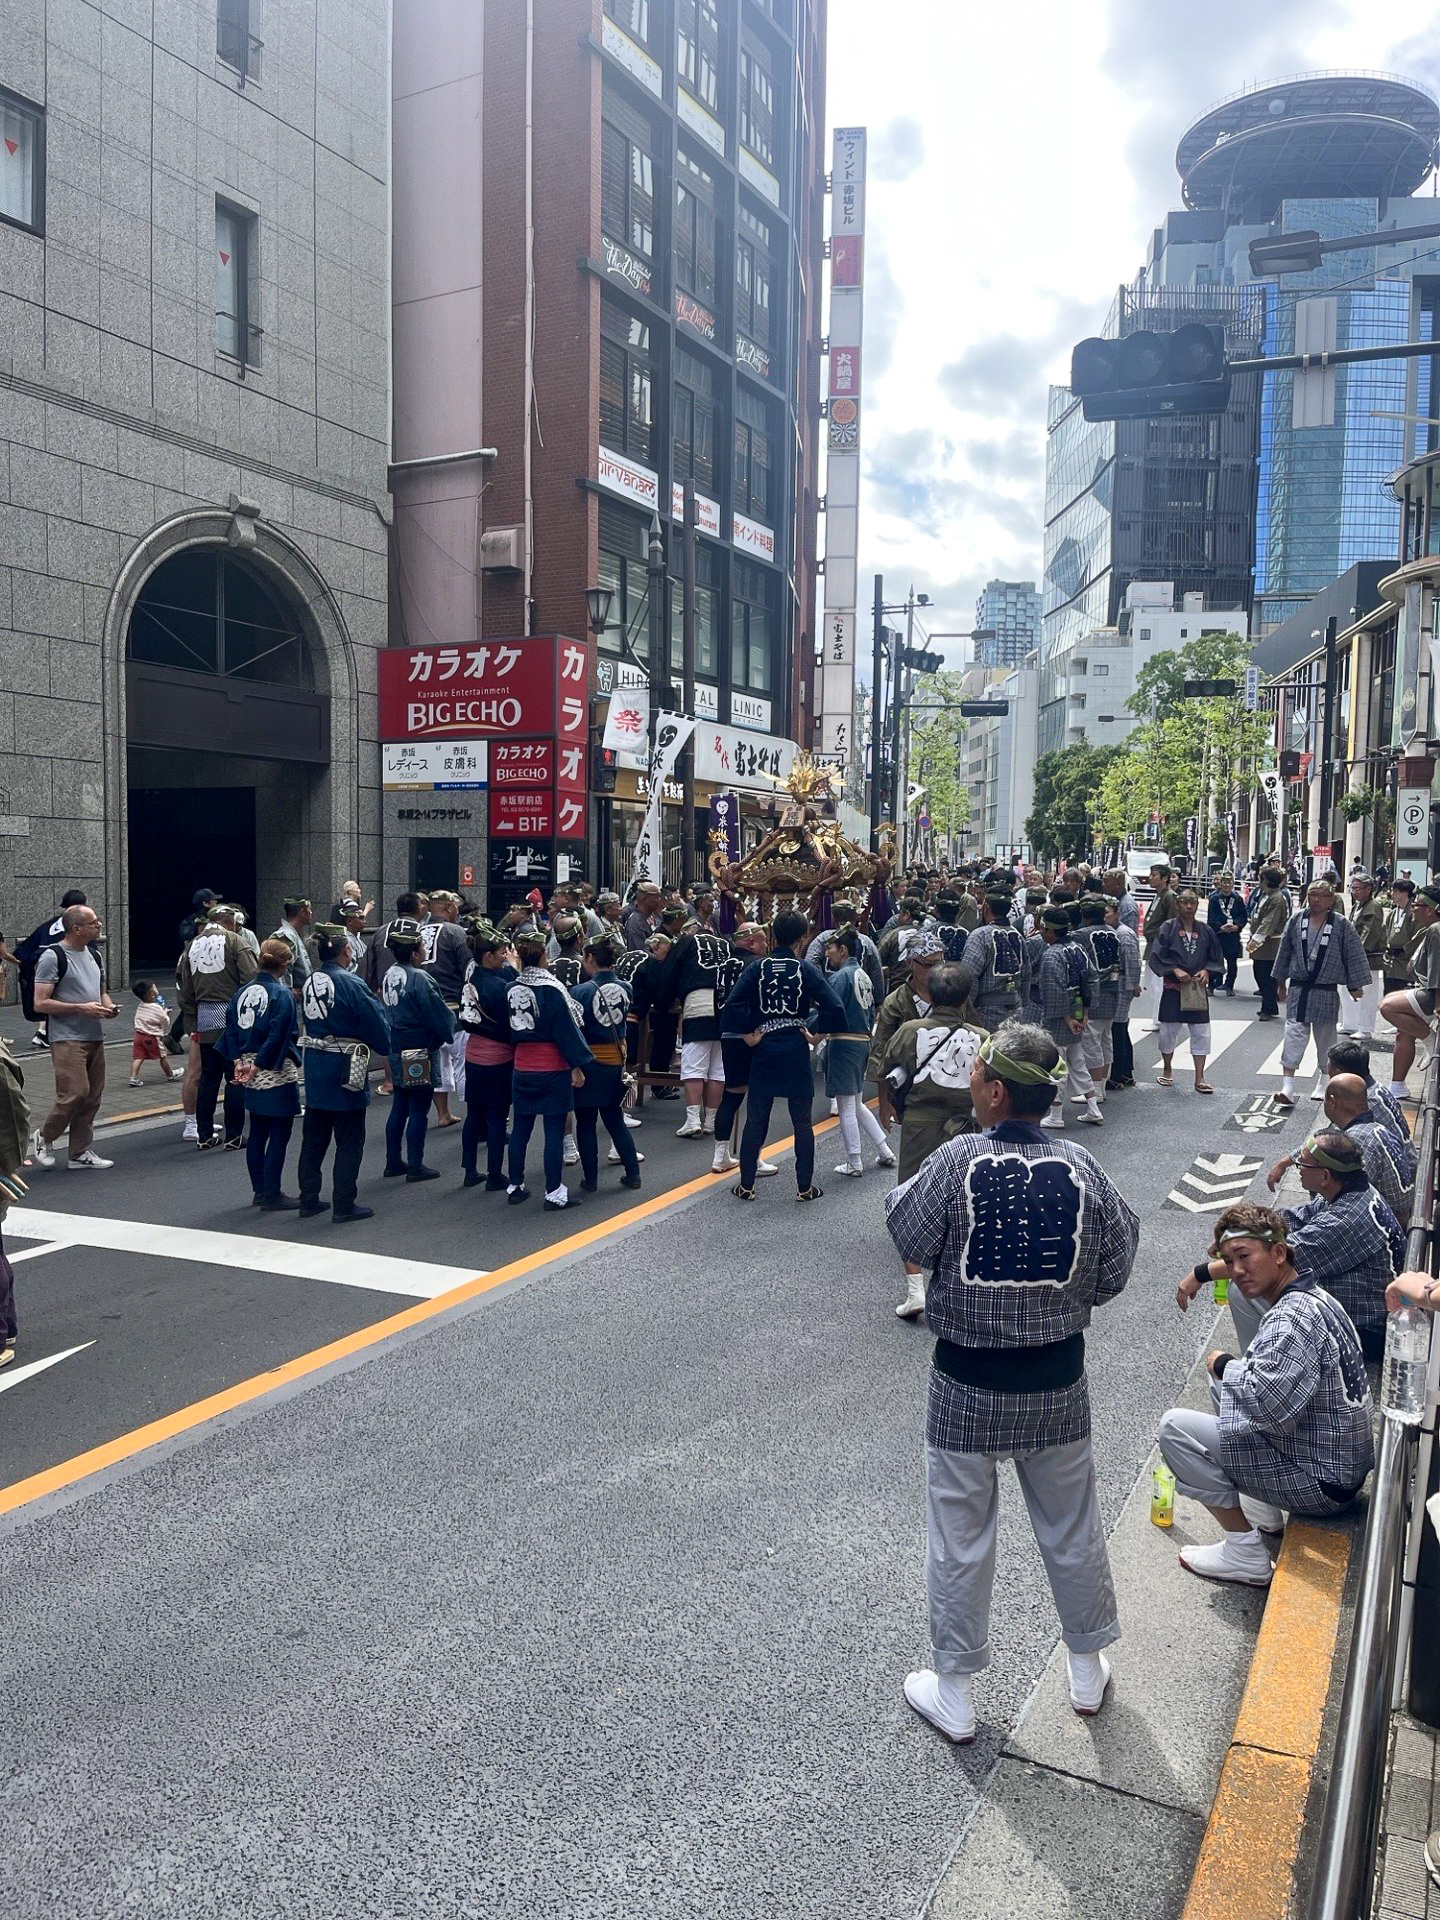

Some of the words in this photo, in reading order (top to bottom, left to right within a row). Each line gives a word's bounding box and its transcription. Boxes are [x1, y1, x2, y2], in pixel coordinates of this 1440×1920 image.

[836, 352, 852, 390] 火鍋屋
[833, 624, 845, 660] 富士そば
[408, 646, 522, 682] カラオケ
[417, 689, 448, 699] Karaoke
[451, 686, 510, 697] Entertainment
[408, 703, 450, 731] BIG
[455, 698, 522, 726] ECHO
[734, 699, 764, 718] LINIC
[613, 709, 645, 733] 祭
[559, 646, 584, 832] カラオケ
[401, 748, 416, 757] 赤坂
[453, 746, 468, 756] 赤坂
[496, 745, 548, 760] カラオケ
[714, 735, 730, 770] 名代
[734, 741, 783, 778] 富士そば
[388, 759, 429, 771] レディース
[444, 757, 477, 770] 皮膚科
[496, 768, 516, 781] BIG
[518, 767, 547, 779] ECHO
[500, 795, 543, 806] 赤坂駅前店
[518, 817, 548, 831] B1F
[527, 846, 548, 864] Bar
